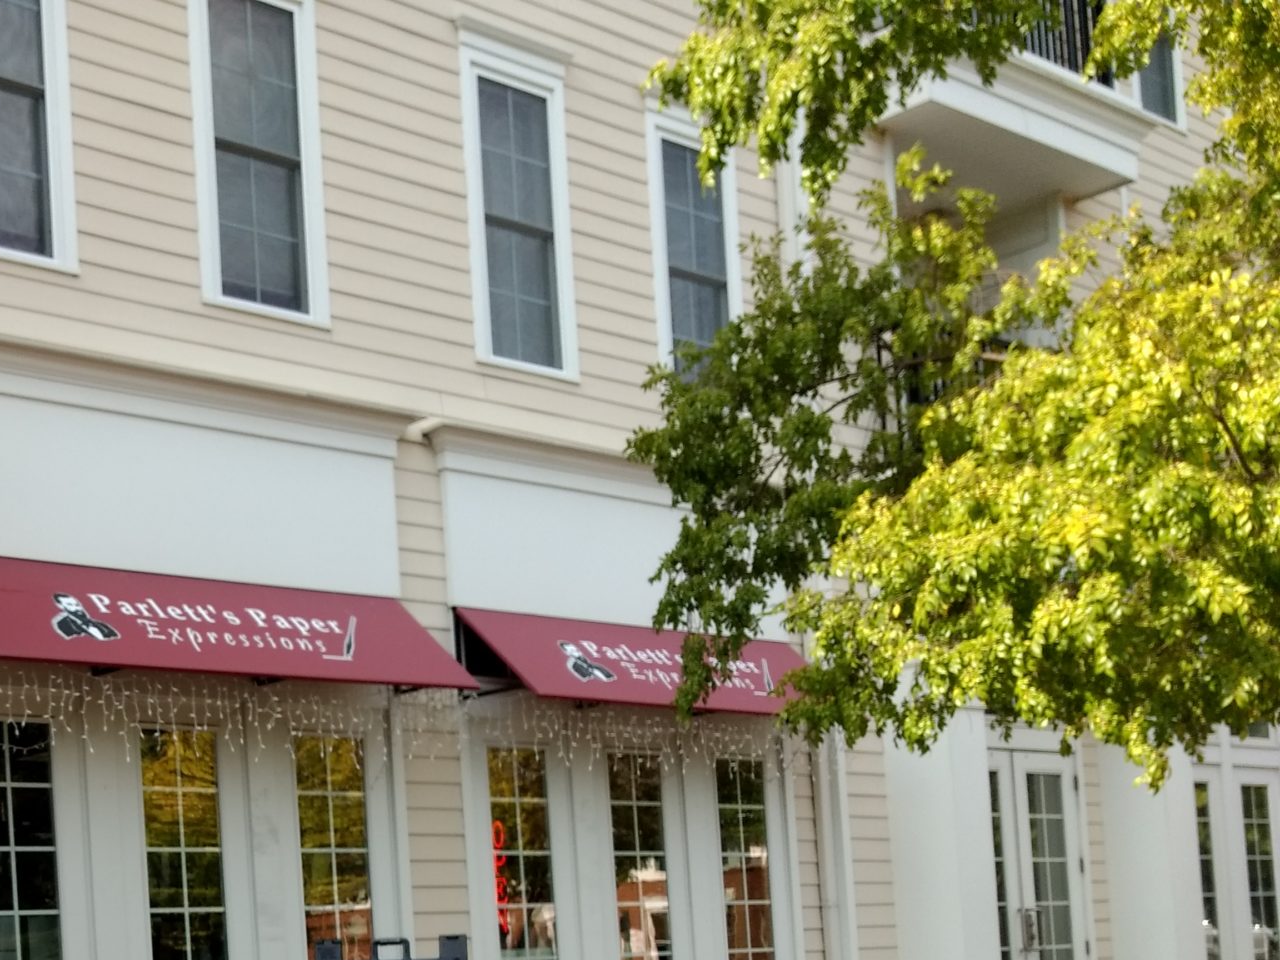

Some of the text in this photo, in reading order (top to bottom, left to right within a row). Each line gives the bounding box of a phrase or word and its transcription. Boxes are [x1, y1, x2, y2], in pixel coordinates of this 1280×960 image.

[87, 592, 344, 636] Parlett's Paper
[136, 618, 327, 653] Expressions
